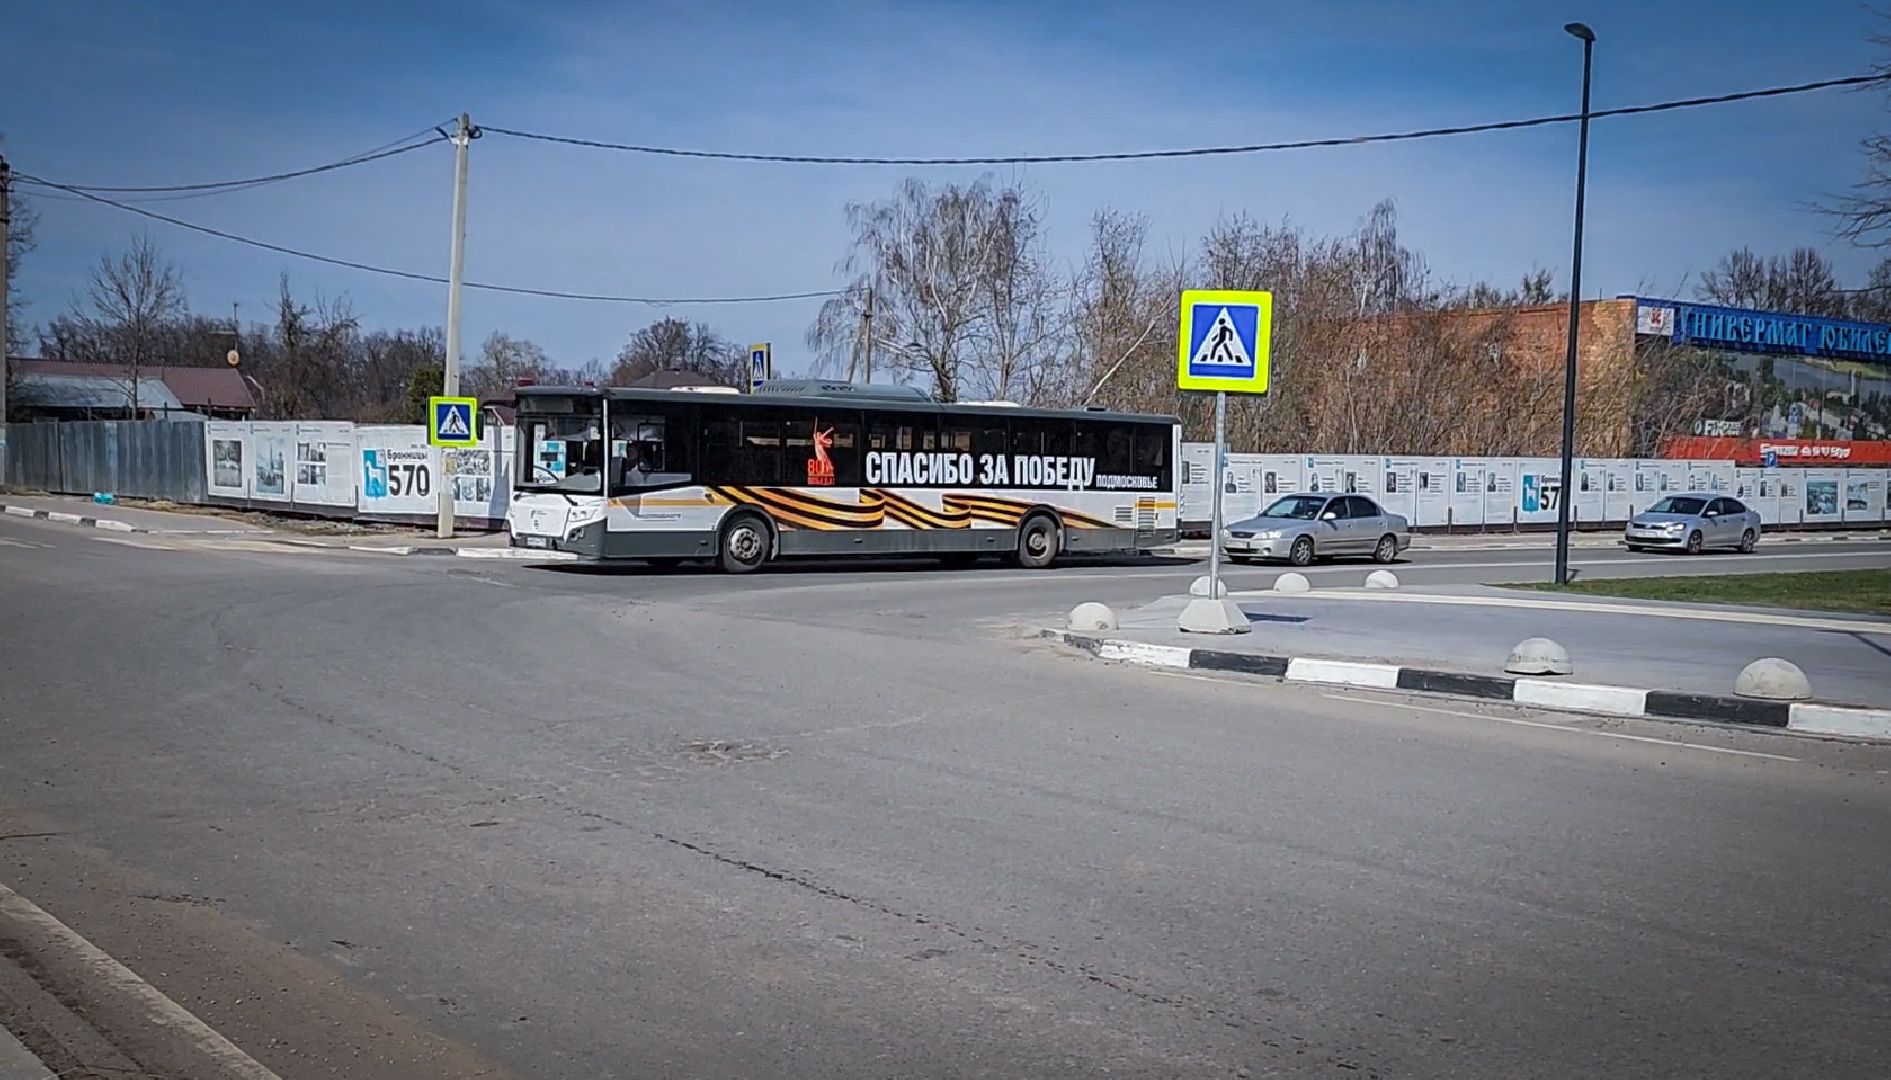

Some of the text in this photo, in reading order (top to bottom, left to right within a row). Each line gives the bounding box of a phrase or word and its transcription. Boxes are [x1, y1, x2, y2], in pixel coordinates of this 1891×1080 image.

[388, 464, 430, 496] 570
[866, 451, 1095, 493] СПАСИБО ЗА ПОБЕДУ
[1095, 474, 1158, 489] ПОДМОСКОВЬЕ
[1541, 486, 1562, 510] 57
